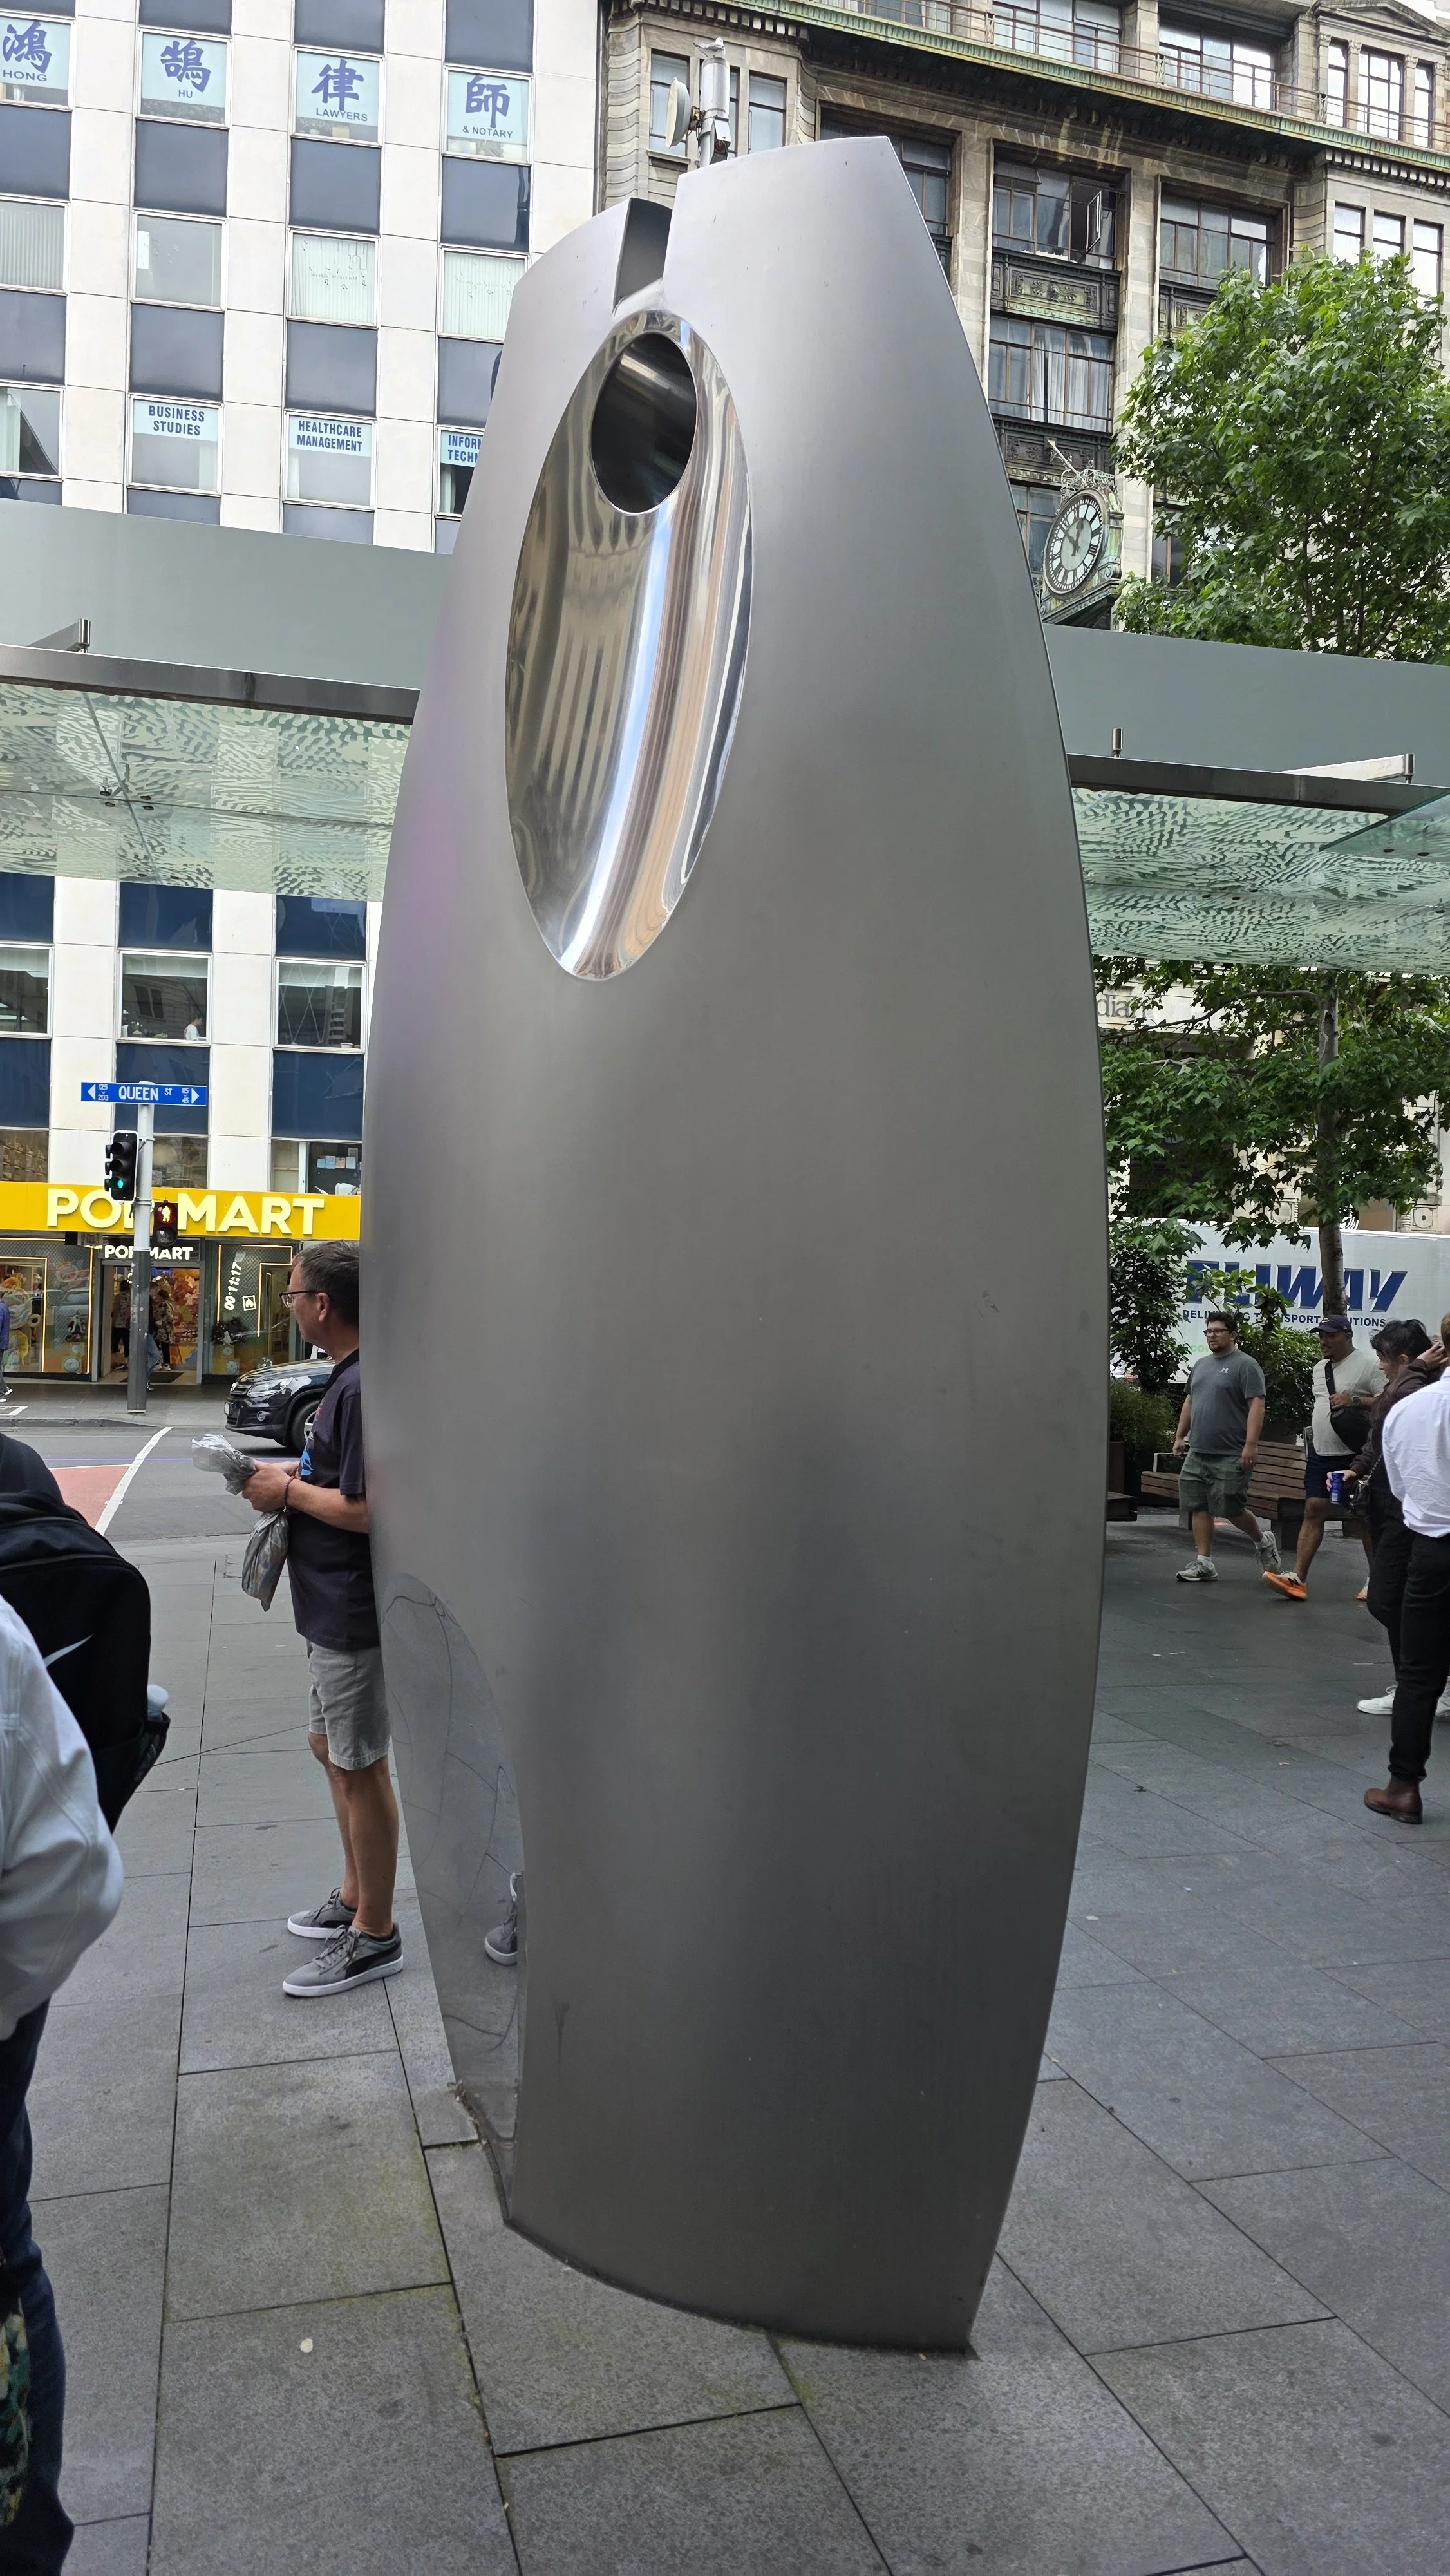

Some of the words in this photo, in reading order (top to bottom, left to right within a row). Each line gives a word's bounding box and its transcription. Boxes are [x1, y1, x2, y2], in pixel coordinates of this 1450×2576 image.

[312, 59, 364, 111] 律
[466, 75, 510, 129] 師
[3, 70, 47, 82] HONG
[178, 90, 193, 99] HU
[316, 108, 368, 122] LAWYERS
[472, 126, 513, 138] NOTARY
[149, 405, 205, 422] BUSINESS
[153, 421, 200, 435] STUDIES
[298, 421, 362, 438] HEALTHCARE
[297, 435, 362, 452] MANAGEMENT
[118, 1086, 158, 1101] QUEEN
[177, 1192, 325, 1235] MART
